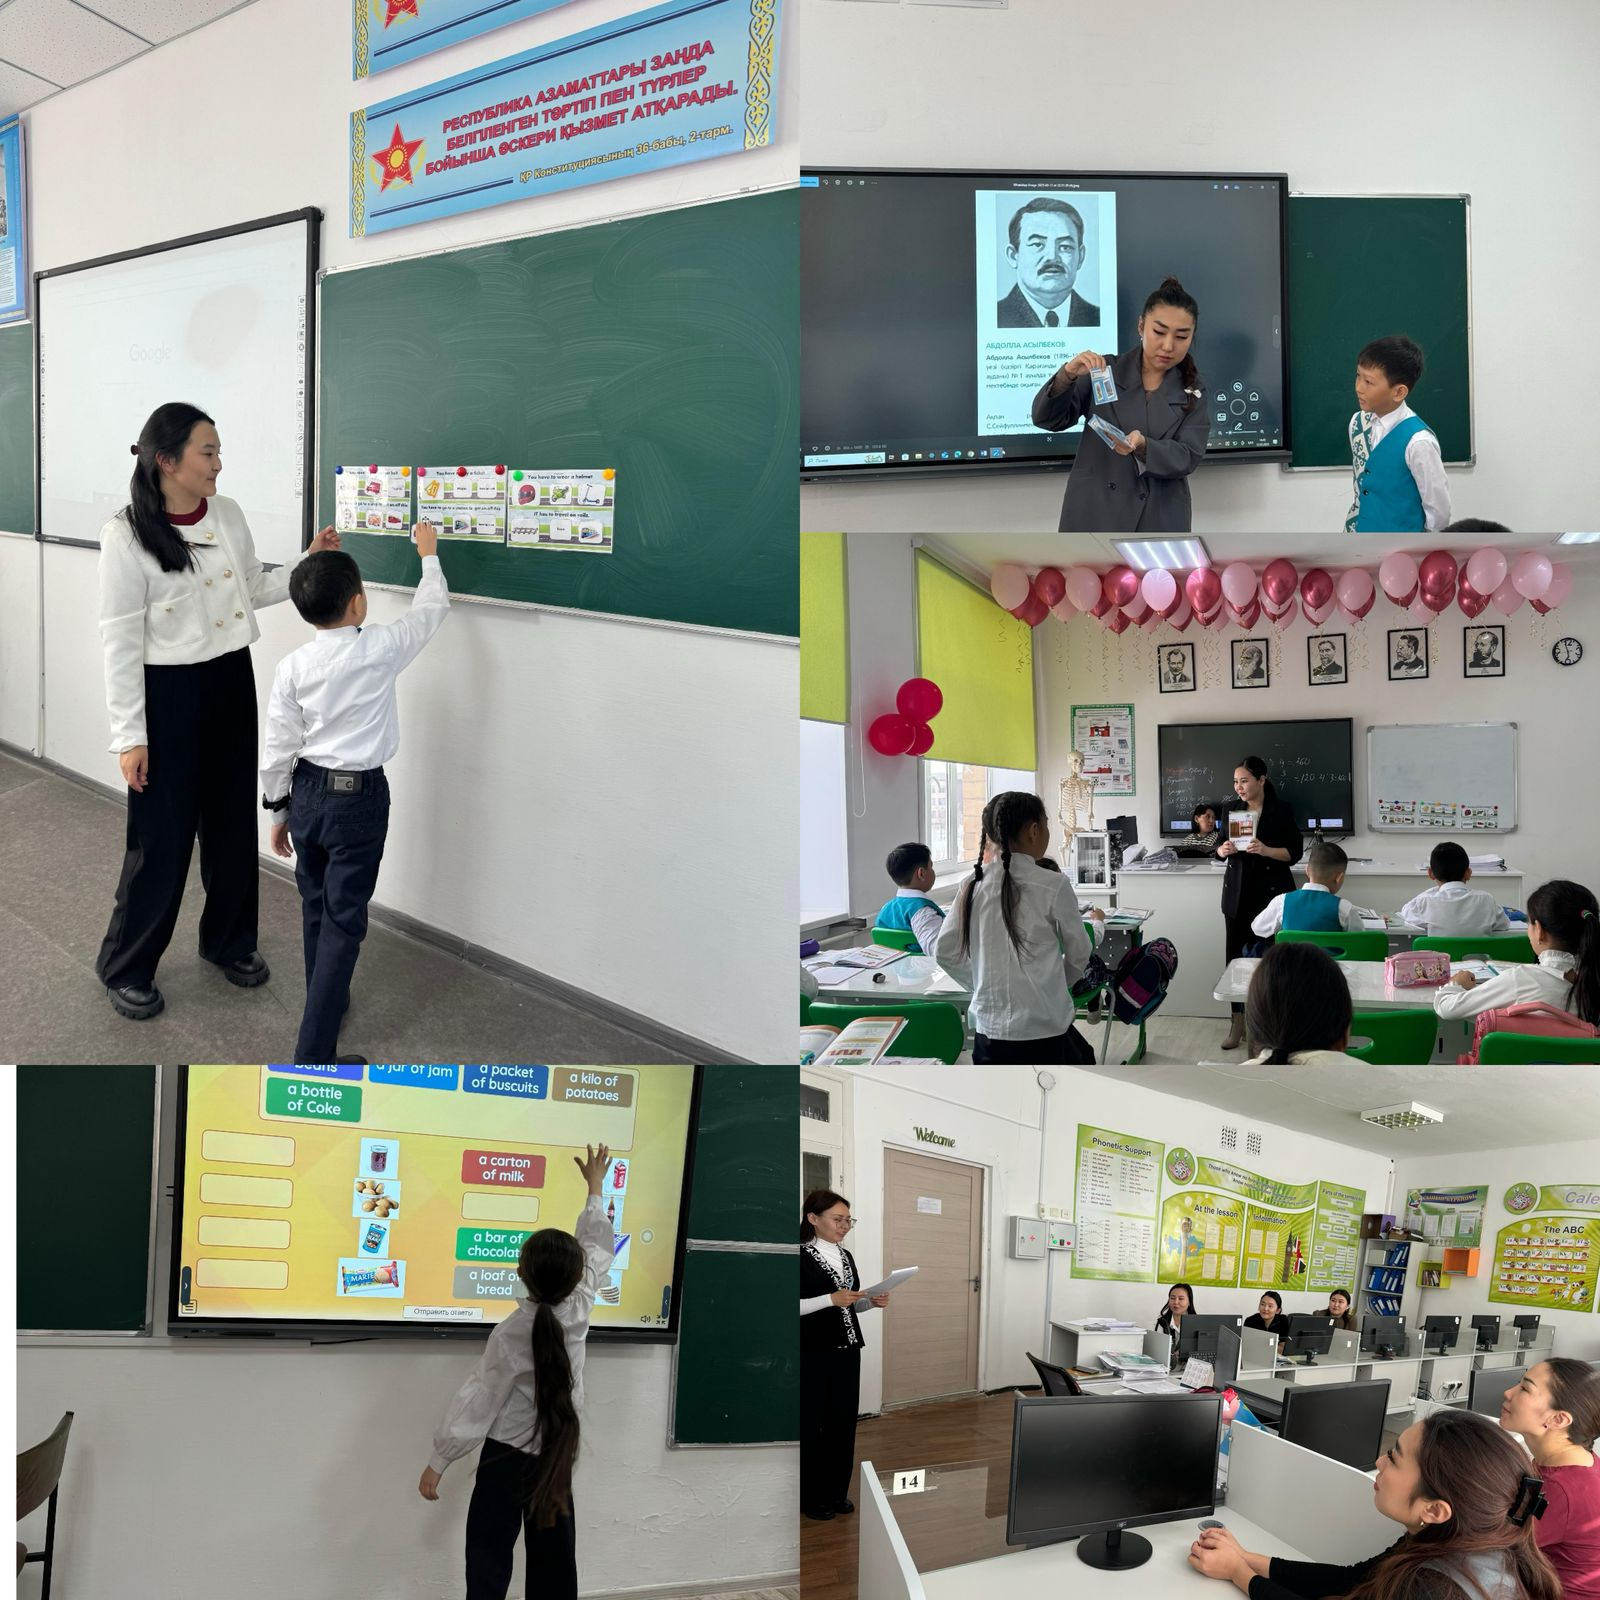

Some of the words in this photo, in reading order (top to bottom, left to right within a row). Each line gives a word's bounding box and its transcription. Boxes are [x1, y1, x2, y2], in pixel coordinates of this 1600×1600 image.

[443, 95, 532, 133] РЕСПУБЛИКА
[535, 59, 646, 105] АЗАМАТТАРЫ
[650, 40, 715, 71] ЗАҢДА
[446, 112, 538, 151] БЕЛГІЛЕНГЕН
[542, 96, 597, 123] ТӘРТІП
[600, 85, 635, 108] ПЕН
[639, 65, 707, 96] ТҮРЛЕР
[425, 146, 496, 176] БОЙЫНША
[498, 128, 557, 156] ӘСКЕРИ
[559, 108, 629, 141] ҚЫЗМЕТ
[631, 80, 738, 121] АТҚАРАДЫ.
[534, 148, 634, 179] Конституциясының
[636, 136, 686, 155] 36-бабы,
[688, 124, 733, 144] 2-тарм.
[129, 340, 171, 365] Google
[427, 1066, 453, 1078] jam
[480, 1065, 488, 1074] a
[491, 1065, 534, 1078] packet
[471, 1077, 486, 1087] of
[489, 1079, 540, 1094] buscuits
[569, 1074, 578, 1083] a
[581, 1072, 601, 1085] kilo
[604, 1076, 619, 1087] of
[287, 1085, 297, 1095] a
[301, 1084, 343, 1100] bottle
[565, 1087, 619, 1102] potatoes
[287, 1099, 303, 1111] of
[306, 1101, 342, 1115] Coke
[913, 1126, 956, 1148] Welcome
[1092, 1137, 1123, 1150] Phonetic
[1124, 1144, 1152, 1157] Support
[479, 1156, 487, 1165] a
[490, 1156, 530, 1169] carton
[482, 1169, 497, 1180] of
[499, 1170, 525, 1182] milk
[1194, 1204, 1202, 1212] At
[1204, 1206, 1215, 1214] the
[1216, 1208, 1238, 1218] lesson
[1253, 1214, 1287, 1225] Information
[1562, 1226, 1585, 1234] ABC
[473, 1232, 482, 1241] a
[485, 1231, 506, 1243] bar
[509, 1233, 524, 1244] of
[467, 1246, 520, 1258] chocolat
[351, 1271, 374, 1282] MARIE
[469, 1271, 478, 1280] a
[481, 1269, 506, 1281] loaf
[476, 1283, 513, 1295] bread
[413, 1308, 449, 1316] Отправить
[900, 1475, 918, 1489] 14
